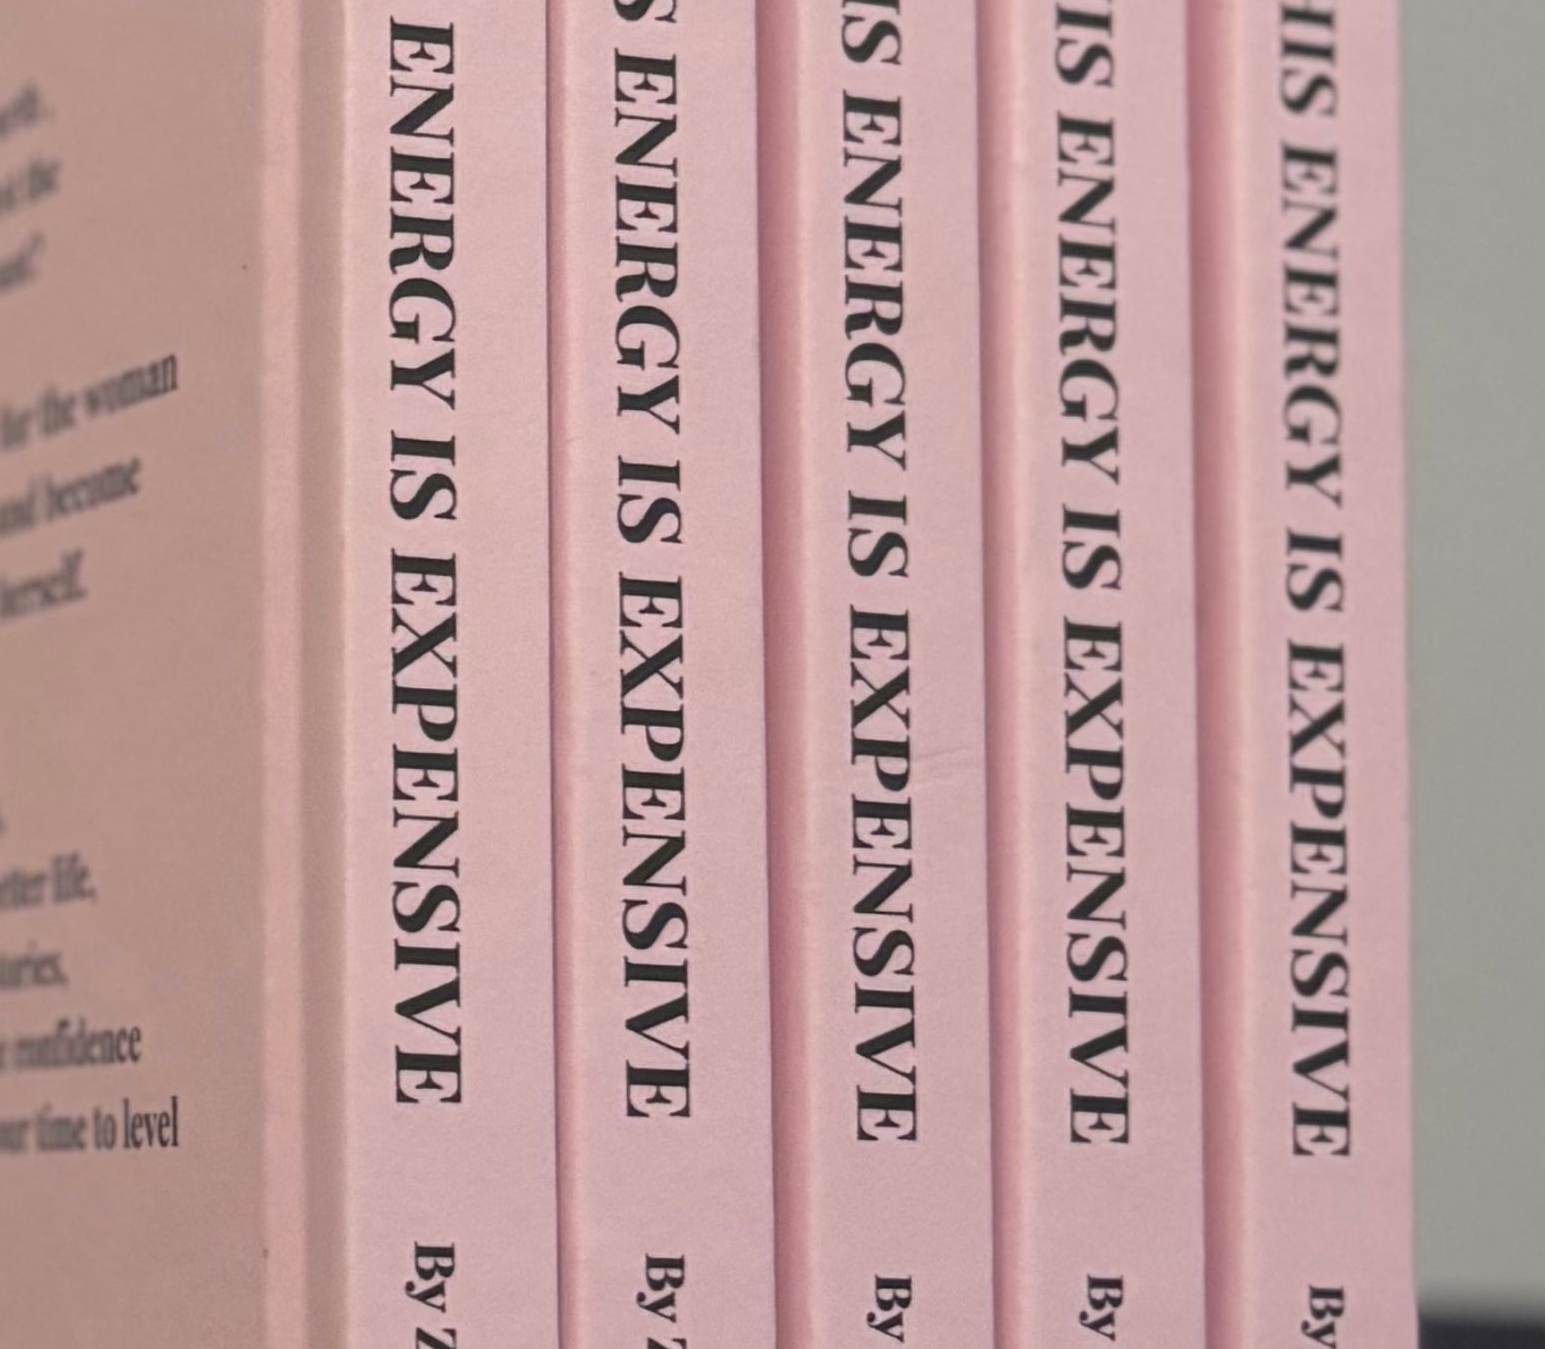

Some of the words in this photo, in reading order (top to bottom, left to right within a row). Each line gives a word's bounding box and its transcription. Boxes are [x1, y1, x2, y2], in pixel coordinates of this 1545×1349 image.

[387, 14, 458, 412] ENERGY
[612, 46, 682, 437] ENERGY
[841, 88, 908, 473] ENERGY
[1055, 110, 1121, 486] ENERGY
[1280, 142, 1343, 508] ENERGY
[388, 428, 459, 522] IS
[615, 453, 684, 546] IS
[845, 488, 910, 579] IS
[1060, 502, 1124, 592] IS
[1285, 528, 1345, 613] IS
[389, 546, 464, 1105] EXPENSIVE
[617, 570, 693, 1120] EXPENSIVE
[848, 602, 919, 1143] EXPENSIVE
[1062, 614, 1131, 1146] EXPENSIVE
[1286, 638, 1352, 1158] EXPENSIVE
[14, 1017, 142, 1070] confidence
[36, 1103, 87, 1152] time
[92, 1108, 118, 1151] to
[122, 1095, 180, 1149] level
[403, 1240, 457, 1315] By
[634, 1252, 687, 1325] By
[865, 1273, 914, 1345] By
[1077, 1273, 1125, 1343] By
